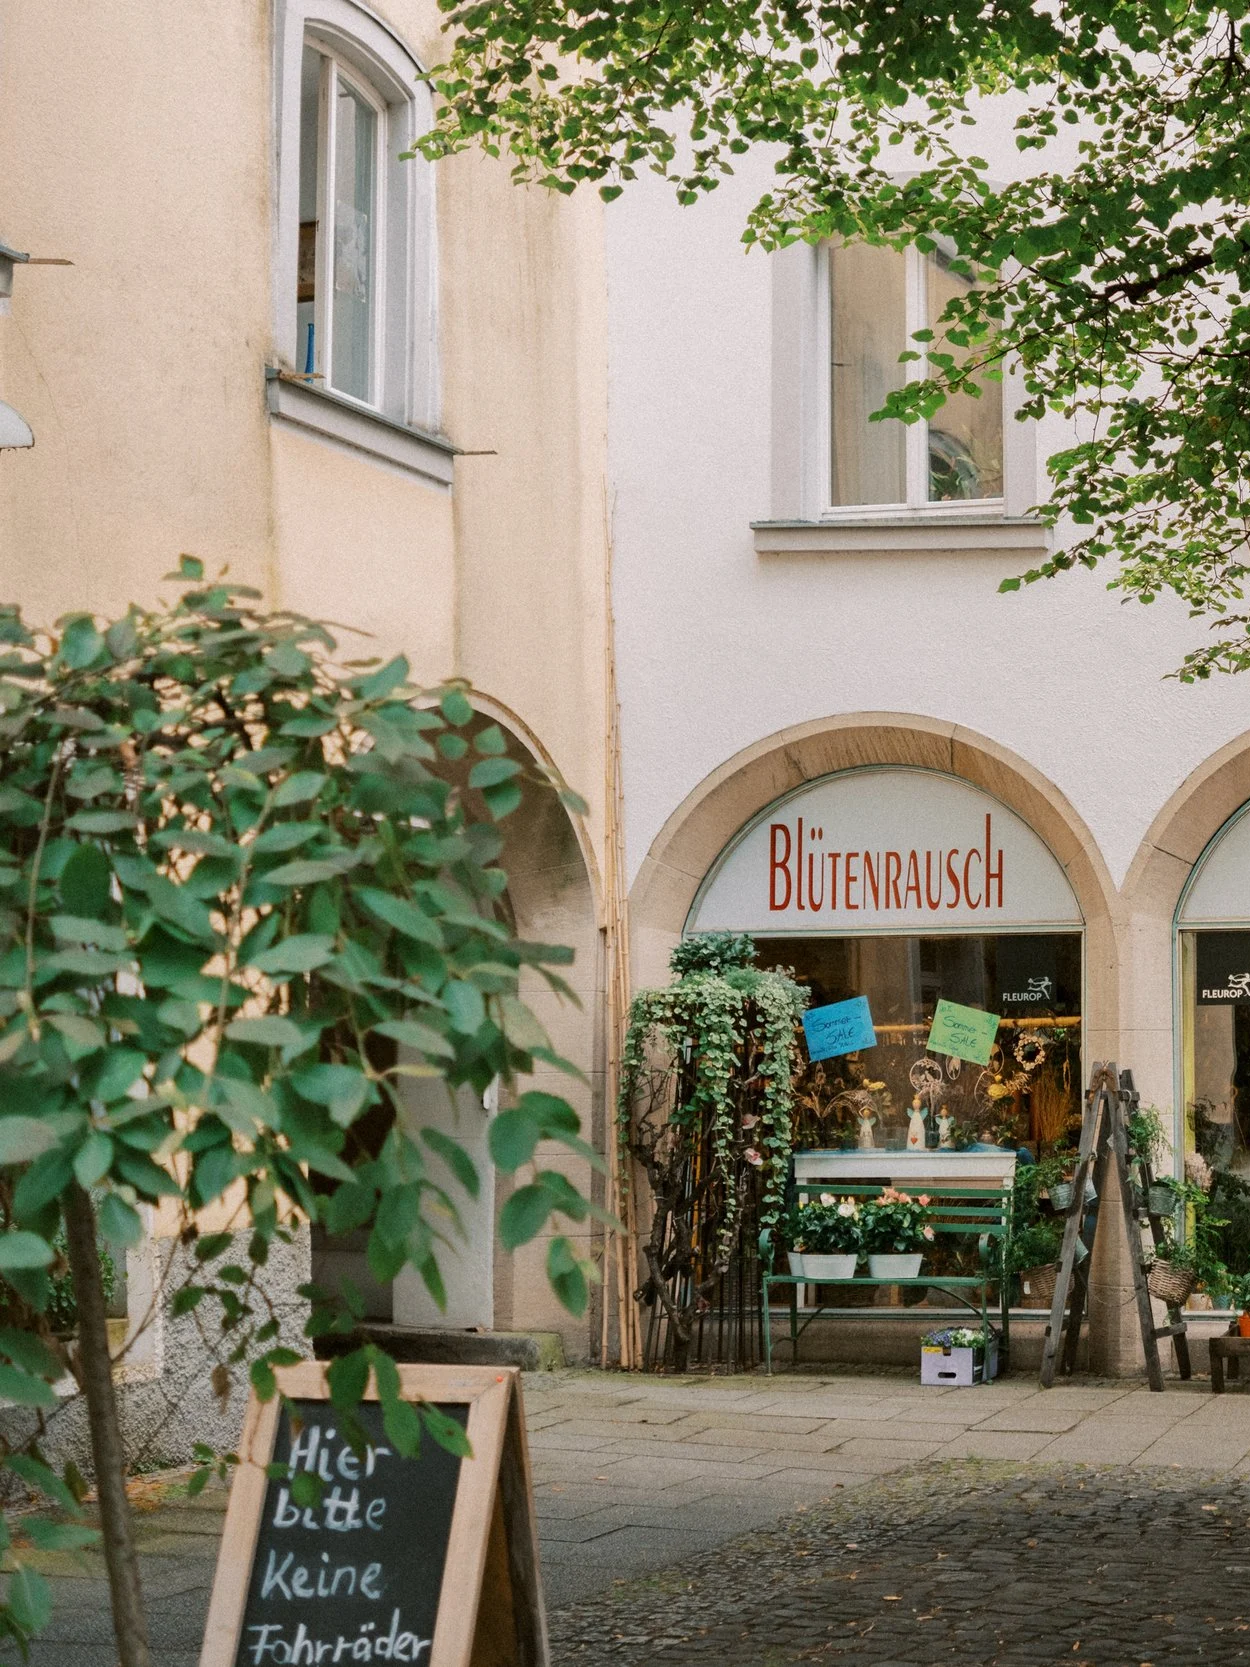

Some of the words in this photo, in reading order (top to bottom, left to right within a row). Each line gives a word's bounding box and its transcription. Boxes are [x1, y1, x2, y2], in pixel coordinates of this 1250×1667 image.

[1002, 992, 1042, 1001] FLEUROP
[1202, 989, 1243, 998] FLEUROP
[825, 1026, 854, 1045] SALE
[949, 1032, 977, 1048] SALE
[287, 1425, 393, 1482] Hier
[273, 1486, 387, 1532] bitte
[260, 1549, 383, 1600] Keine
[247, 1607, 432, 1667] Fahrräder
